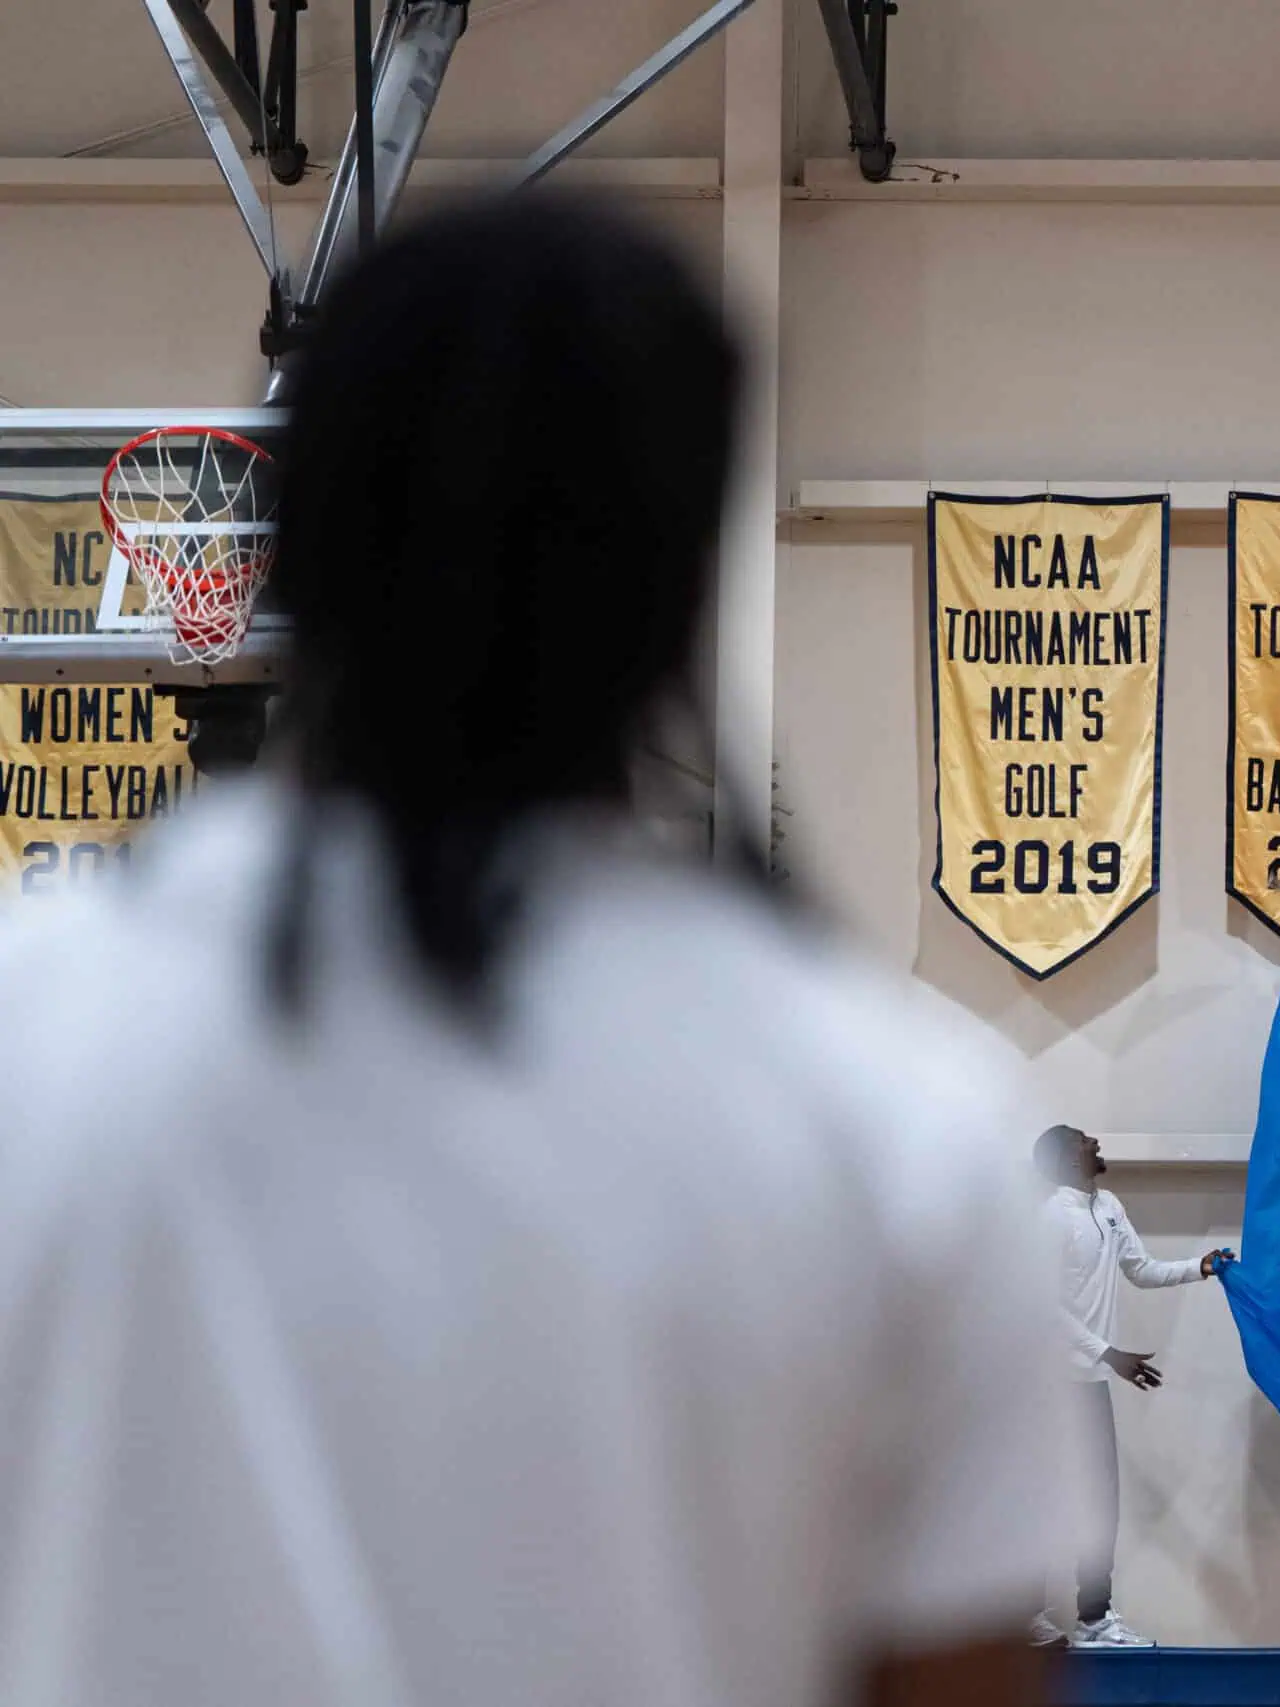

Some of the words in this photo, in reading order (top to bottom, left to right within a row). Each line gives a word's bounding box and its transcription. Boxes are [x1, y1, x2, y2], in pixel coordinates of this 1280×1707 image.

[994, 534, 1101, 589] NCAA
[945, 607, 1152, 666] TOURNAMENT
[990, 686, 1104, 742] MEN'S
[1005, 763, 1088, 818] GOLF
[970, 839, 1121, 895] 2019
